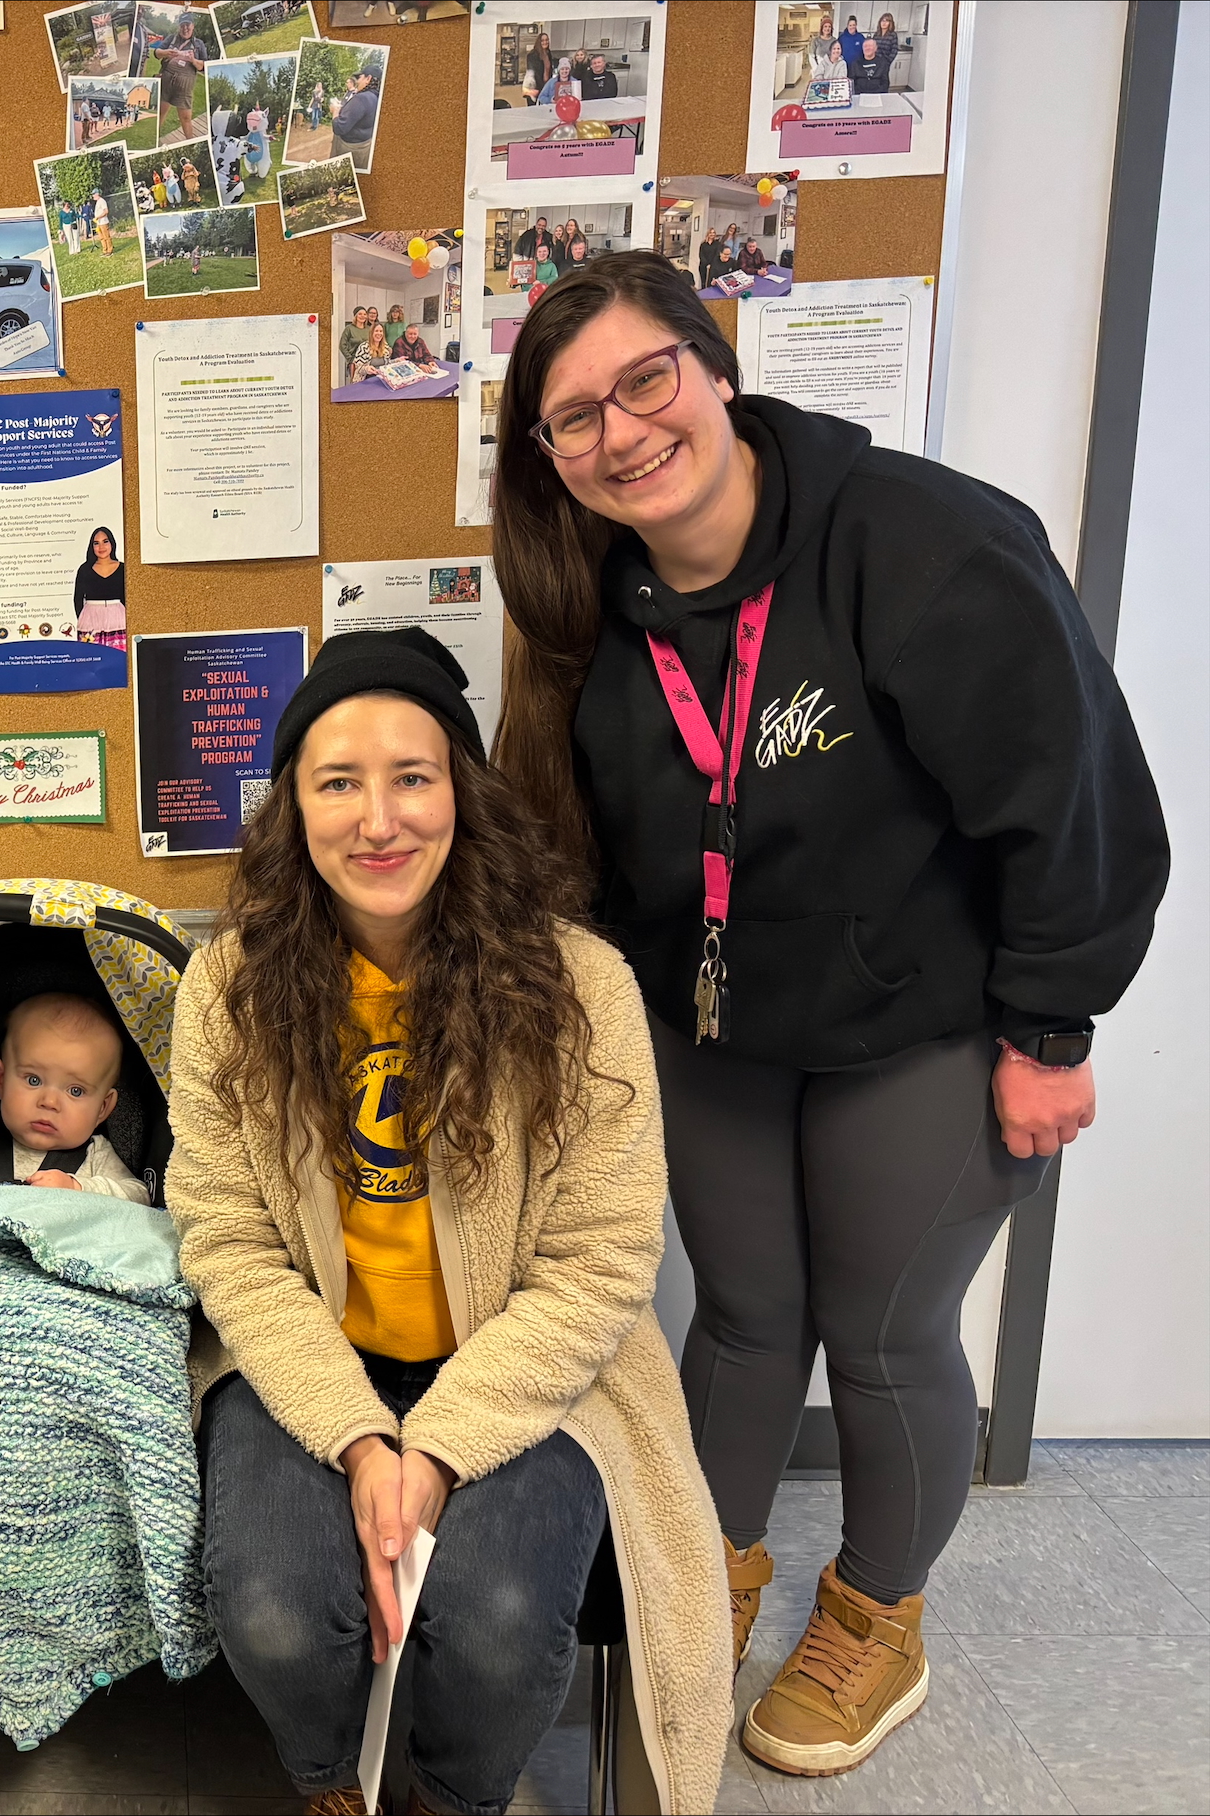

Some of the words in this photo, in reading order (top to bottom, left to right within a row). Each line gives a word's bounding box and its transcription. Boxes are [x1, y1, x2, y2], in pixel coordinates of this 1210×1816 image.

[6, 415, 78, 428] Post-Majority
[27, 429, 74, 440] Services
[183, 686, 258, 701] EXPLOITATION
[261, 686, 269, 698] &
[207, 703, 245, 716] HUMAN
[192, 718, 261, 733] TRAFFICKING
[202, 750, 252, 764] PROGRAM
[12, 776, 95, 804] Christmas
